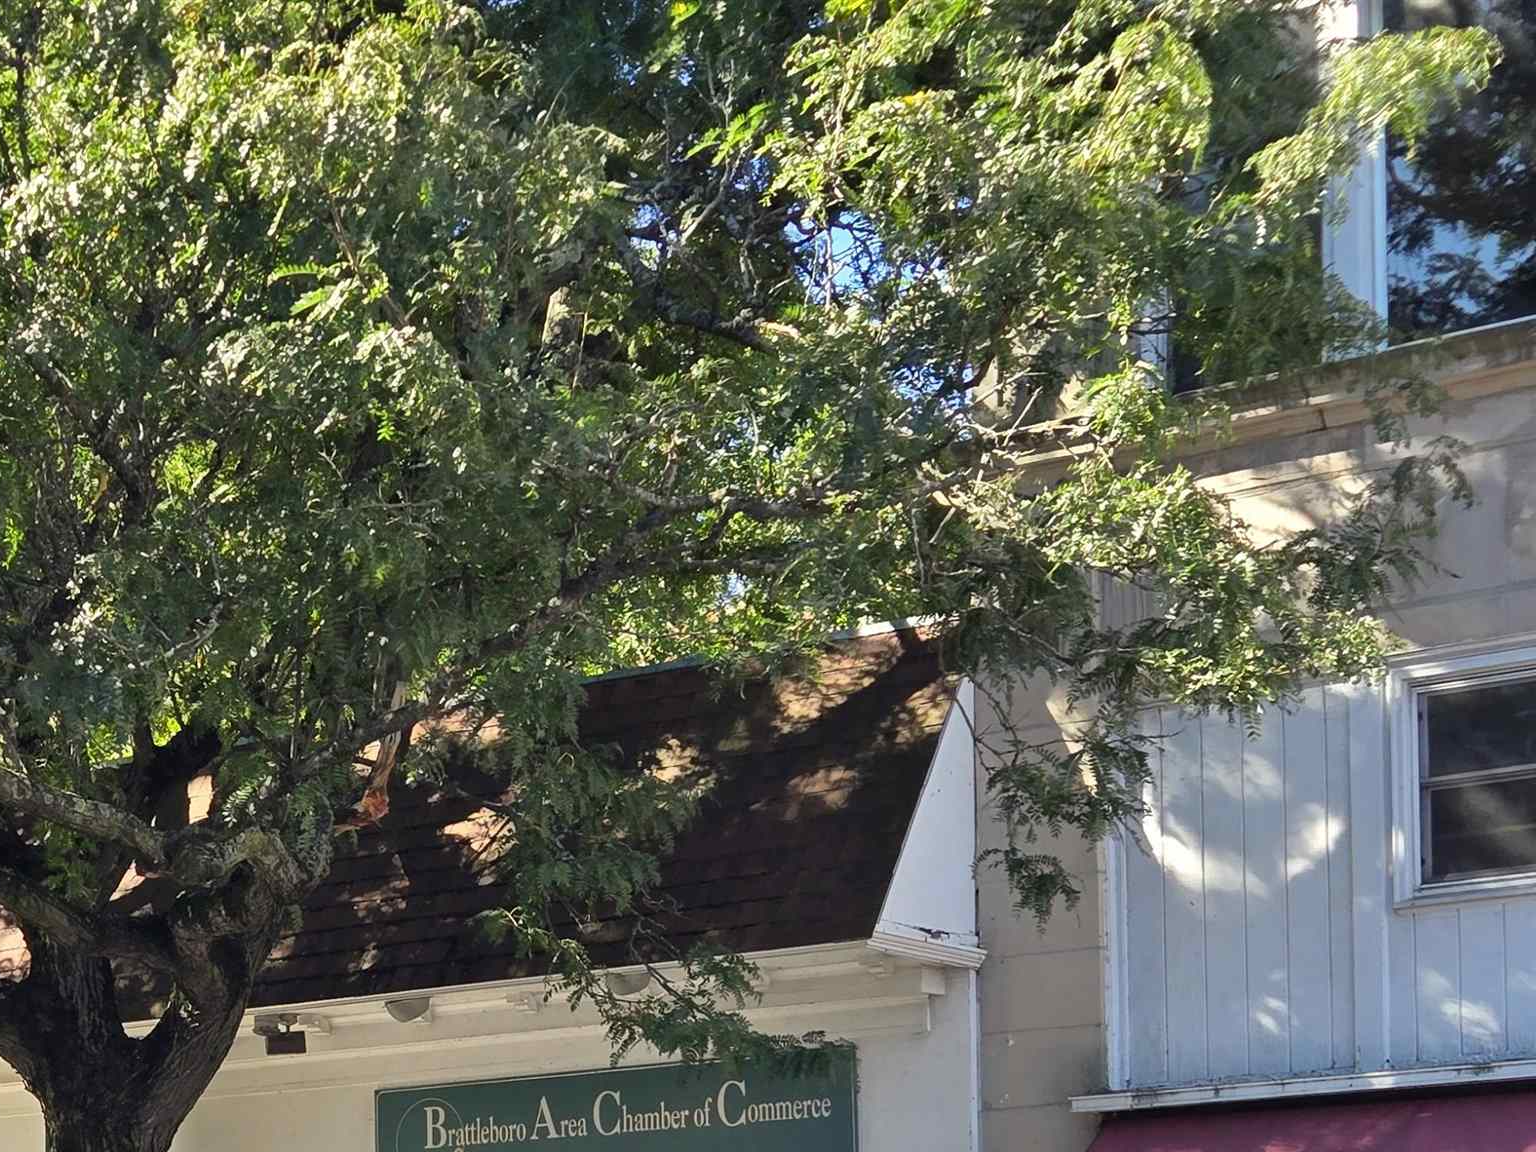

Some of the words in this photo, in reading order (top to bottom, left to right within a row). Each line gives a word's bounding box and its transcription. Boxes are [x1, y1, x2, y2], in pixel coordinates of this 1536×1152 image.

[423, 1105, 527, 1149] Brattleboro
[530, 1095, 588, 1141] Area
[592, 1090, 689, 1136] Chamber
[693, 1097, 713, 1129] of
[716, 1080, 832, 1128] Commerce
